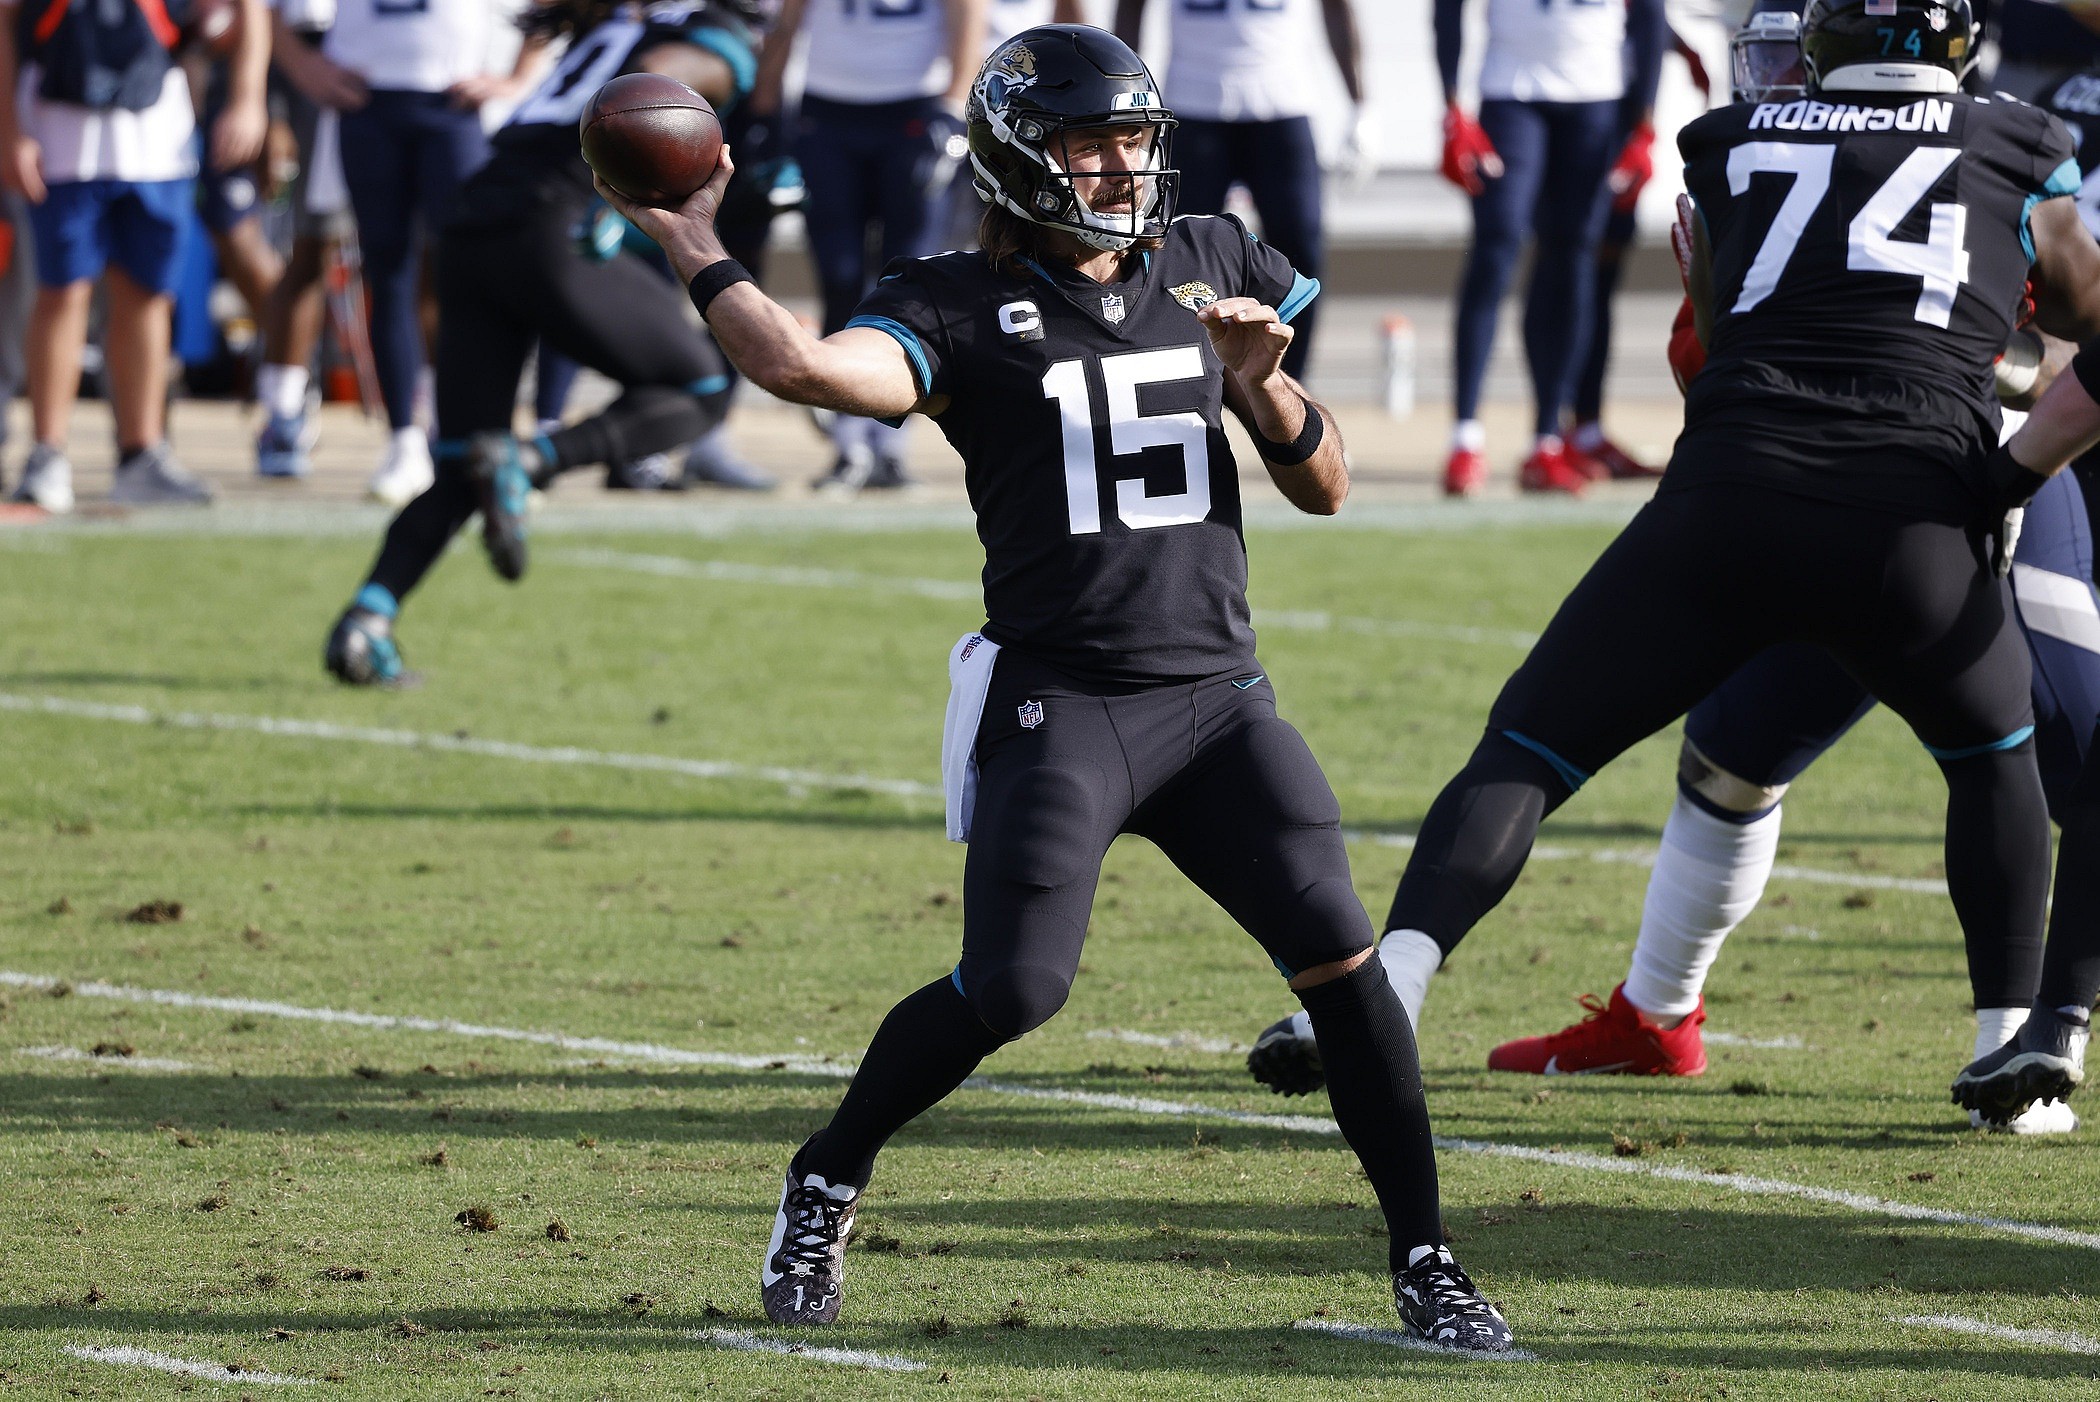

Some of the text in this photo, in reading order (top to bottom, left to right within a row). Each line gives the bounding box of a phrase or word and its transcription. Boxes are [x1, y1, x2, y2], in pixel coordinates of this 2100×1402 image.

[1876, 28, 1922, 57] 74
[1130, 92, 1150, 107] JAX
[1748, 99, 1953, 133] ROBINSON
[1726, 142, 1969, 329] 74
[998, 300, 1039, 334] C
[1042, 347, 1211, 535] 15
